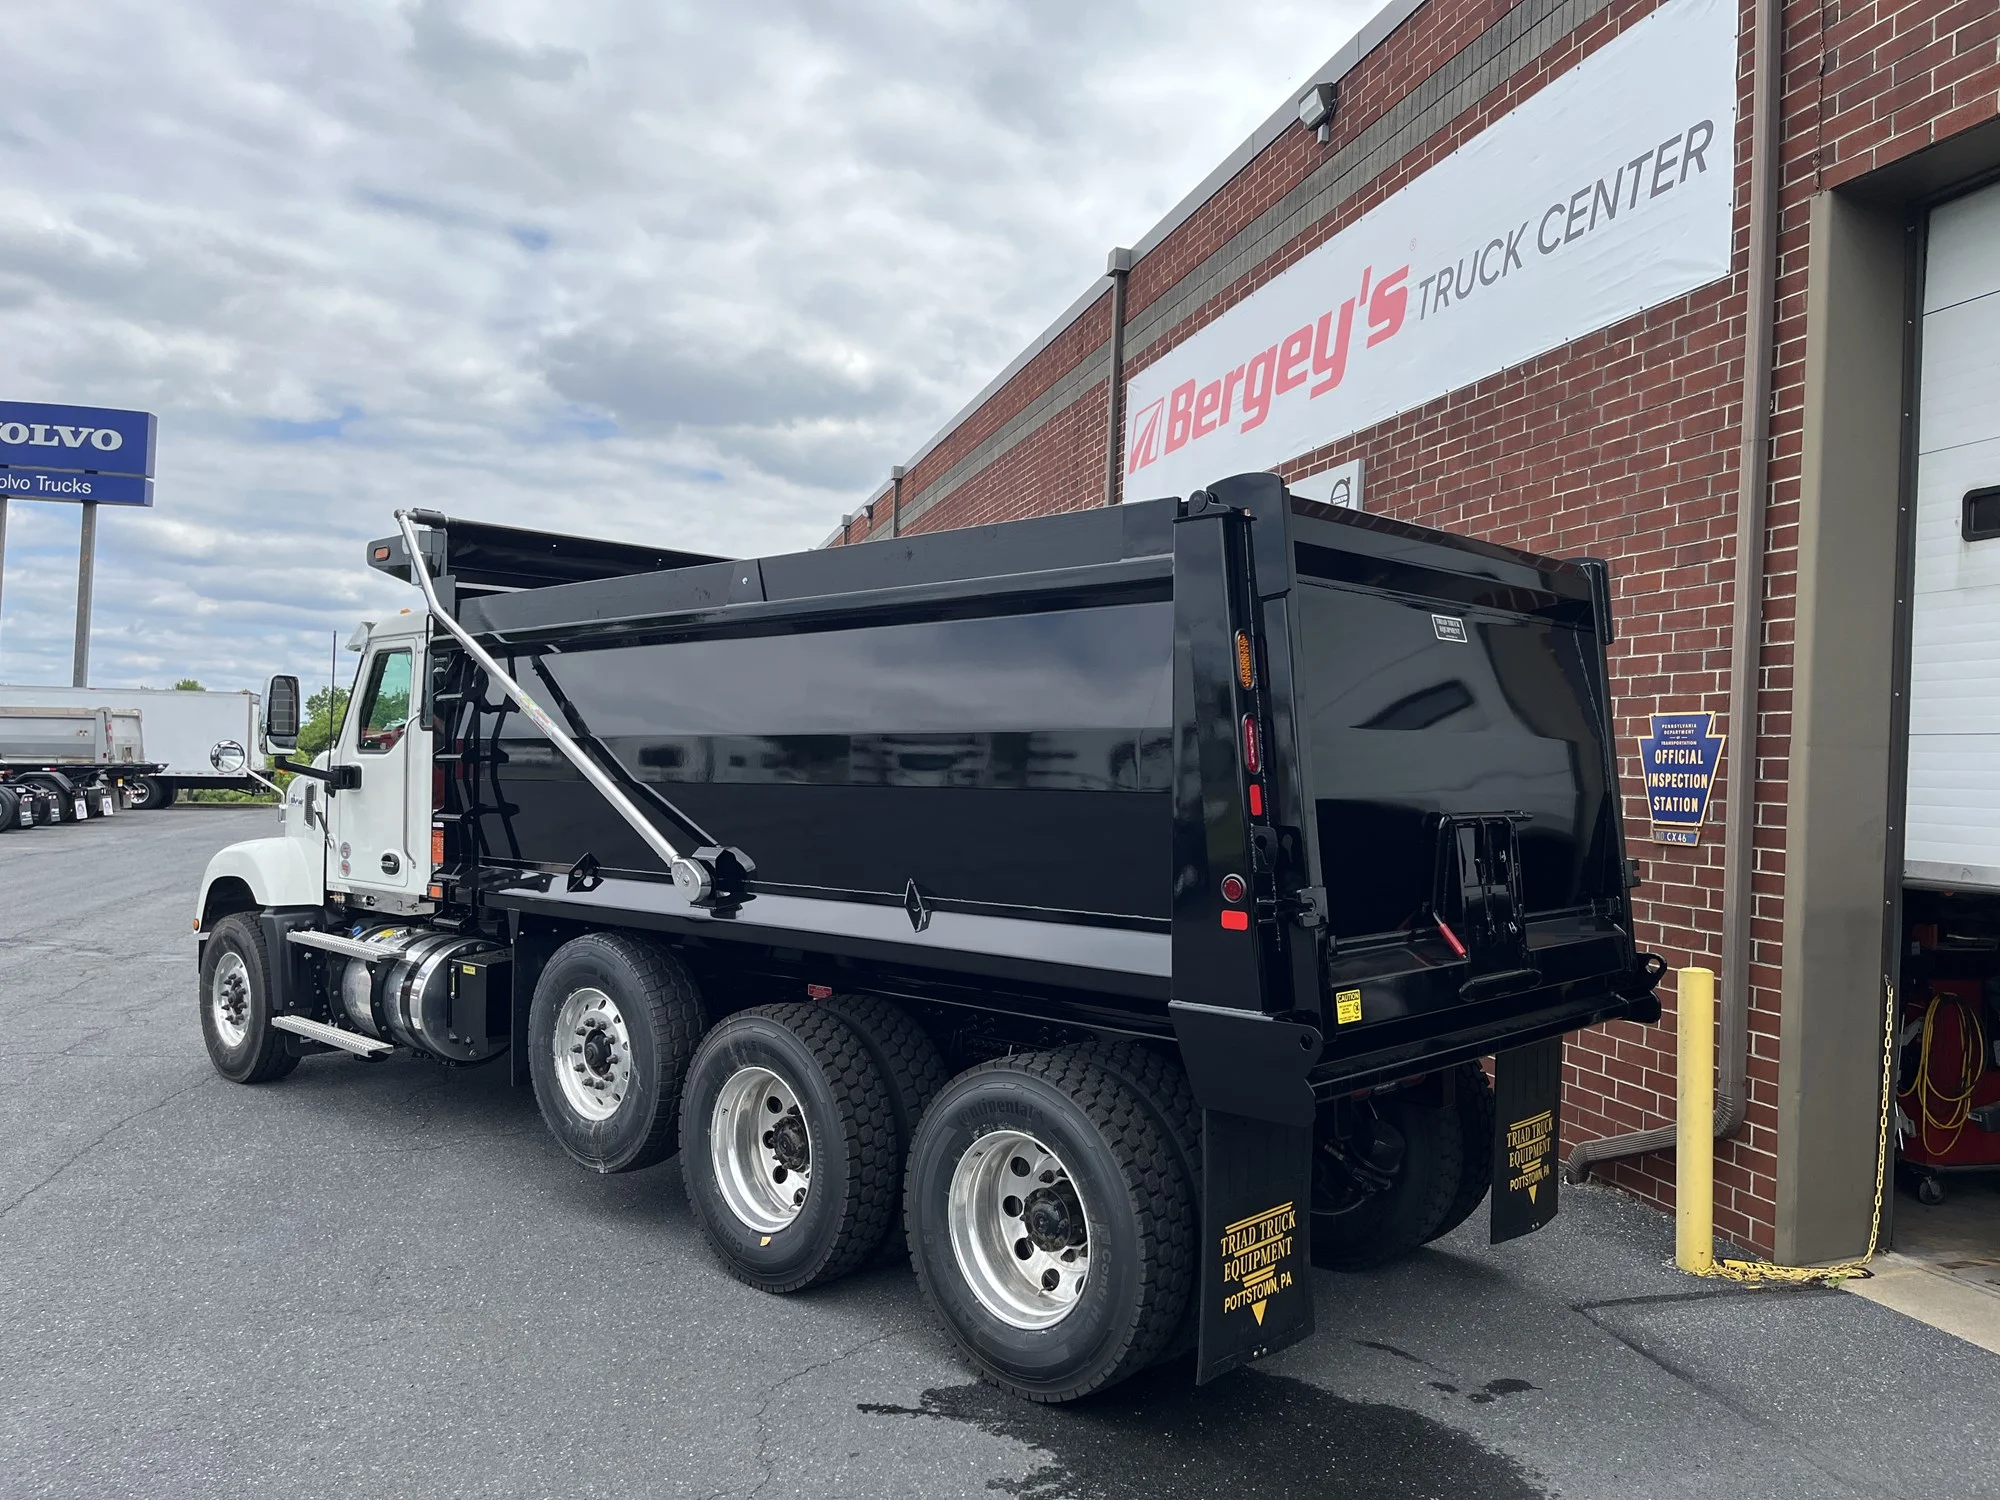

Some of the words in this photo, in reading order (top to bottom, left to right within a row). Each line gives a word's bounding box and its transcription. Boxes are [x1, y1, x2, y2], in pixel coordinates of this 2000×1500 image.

[1163, 265, 1410, 456] Bergey's
[1418, 221, 1530, 321] TRUCK
[1537, 118, 1714, 256] CENTER
[0, 422, 122, 451] OLVO
[0, 474, 30, 490] olvo
[36, 475, 92, 494] Trucks
[1655, 749, 1704, 765] OFFICIAL
[1648, 773, 1708, 789] INSPECTION
[1654, 796, 1698, 812] STATION
[1338, 992, 1359, 1003] CAUTION
[958, 1098, 1034, 1128] Continental
[1507, 1126, 1531, 1147] TRIAD
[1532, 1117, 1553, 1136] TRUCK
[1509, 1137, 1551, 1168] EQUIPMENT
[1543, 1164, 1550, 1178] PA
[1220, 1226, 1256, 1257] TRIAD
[1259, 1210, 1296, 1240] TRUCK
[1223, 1236, 1293, 1282] EQUIPMENT
[1224, 1277, 1280, 1314] POTTSTOWN,
[1280, 1271, 1293, 1289] PA
